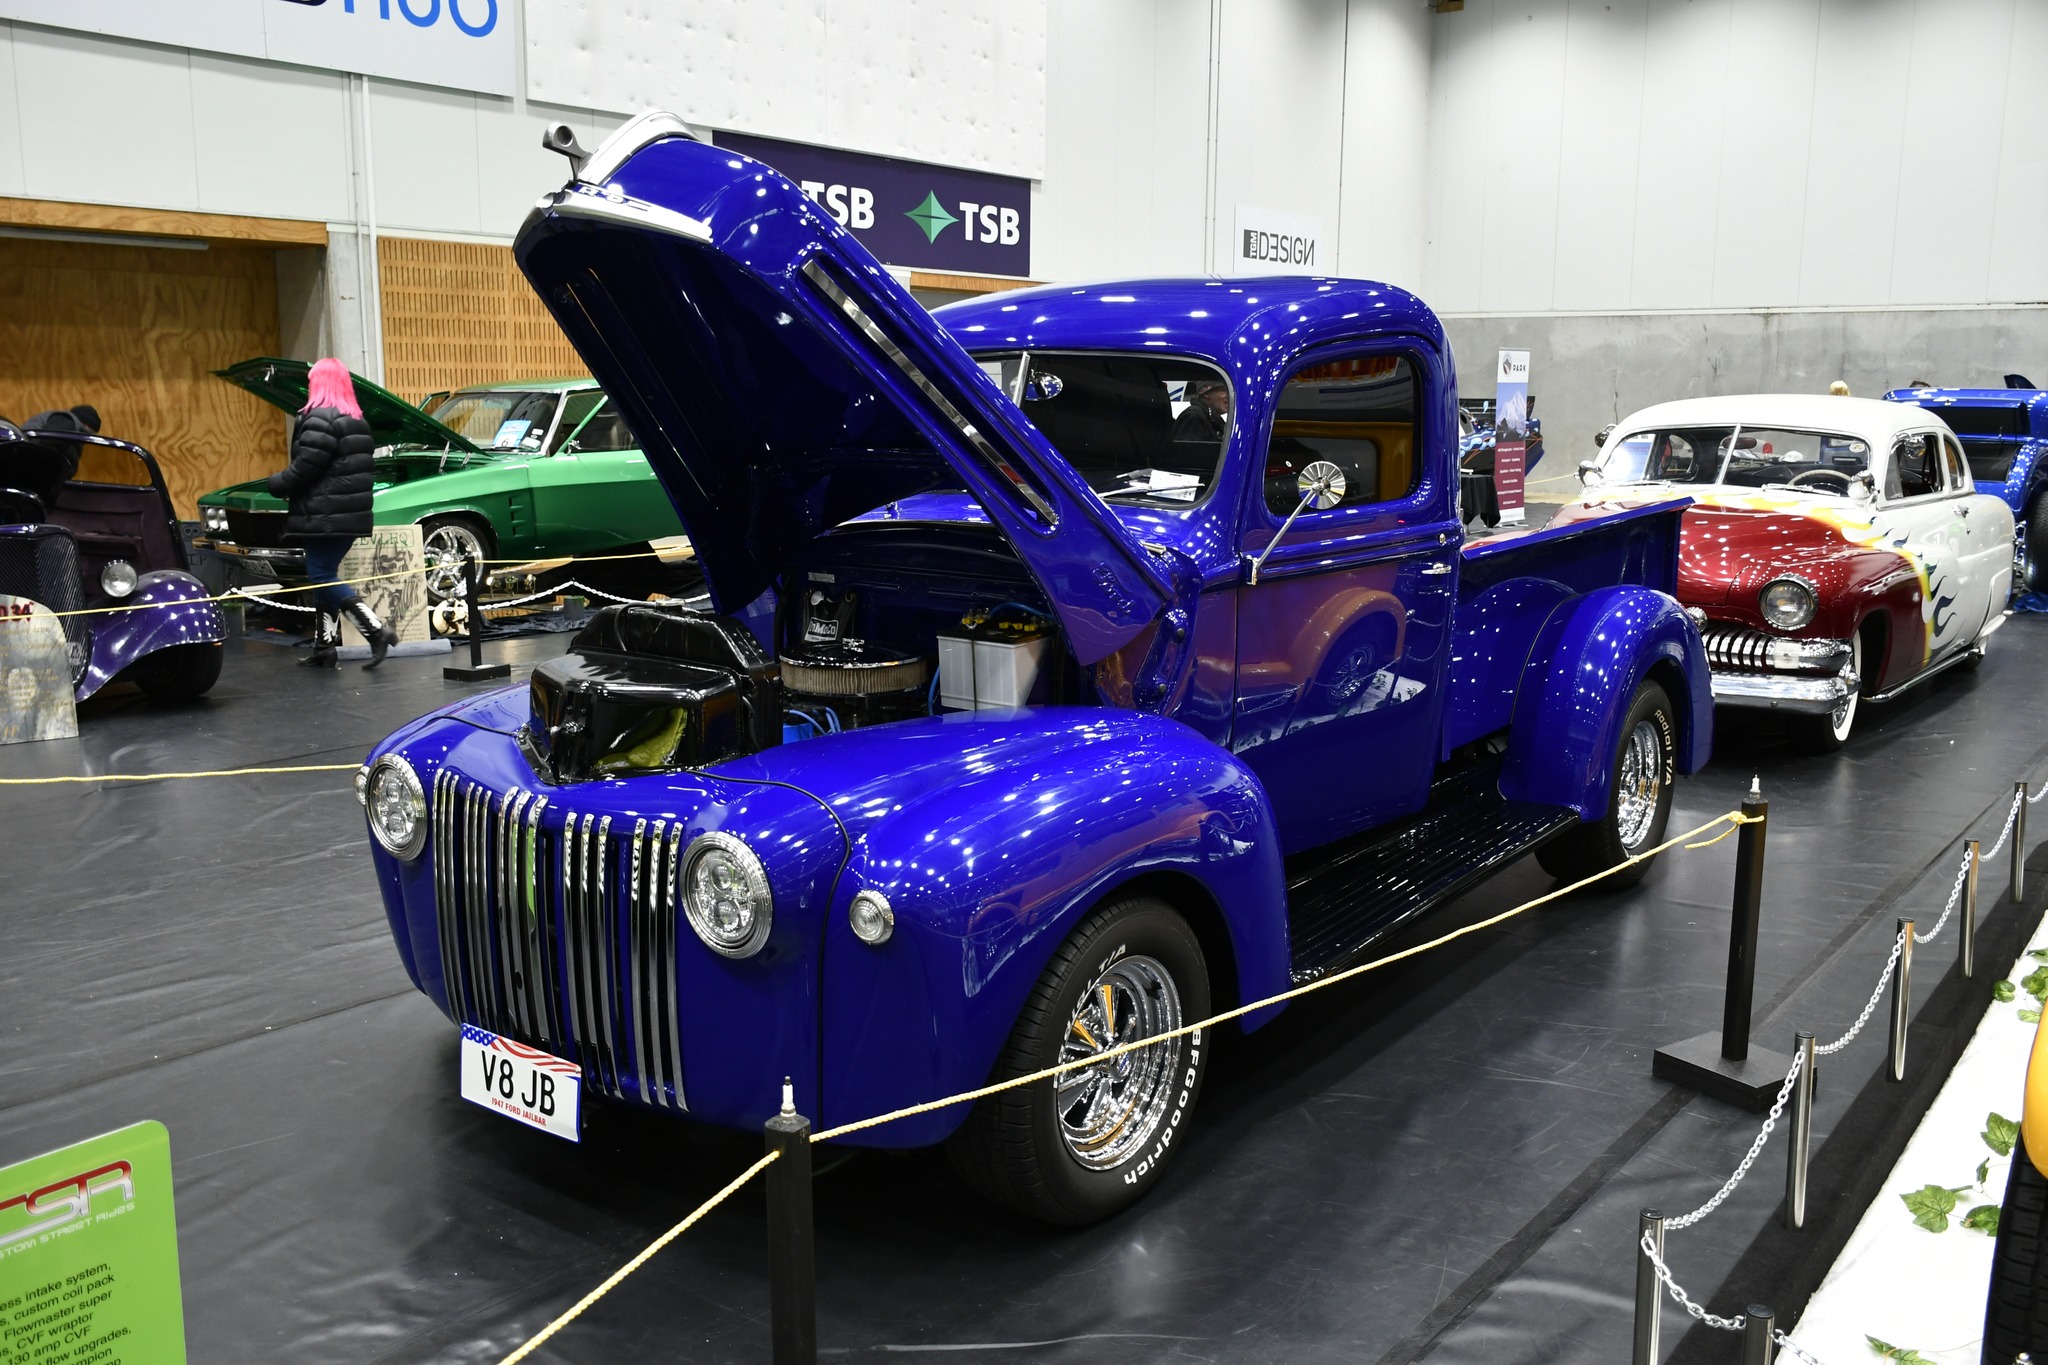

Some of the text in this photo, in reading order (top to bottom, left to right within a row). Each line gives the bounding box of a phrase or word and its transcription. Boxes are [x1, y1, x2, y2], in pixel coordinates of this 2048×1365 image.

[800, 180, 875, 230] TSB
[959, 201, 1020, 246] TSB
[1258, 231, 1315, 267] DESIGN
[352, 532, 408, 546] EVLHQ
[1653, 708, 1674, 786] Radial T/A
[1098, 944, 1126, 974] T/A
[481, 1050, 556, 1117] V8 JB
[491, 1097, 547, 1127] 1947 FORD JAILBAR
[1124, 1028, 1204, 1186] BFGoodrich
[14, 1297, 59, 1321] custom
[63, 1285, 83, 1301] coil
[87, 1273, 115, 1294] pack
[25, 1280, 62, 1302] intake
[66, 1263, 111, 1286] system,
[4, 1304, 76, 1341] Flowmaster
[79, 1290, 112, 1310] super
[17, 1311, 94, 1349] CVF wraptor
[8, 1351, 30, 1365] 130
[34, 1340, 61, 1358] amp
[64, 1325, 92, 1344] CVF
[73, 1326, 132, 1356] upgrades,
